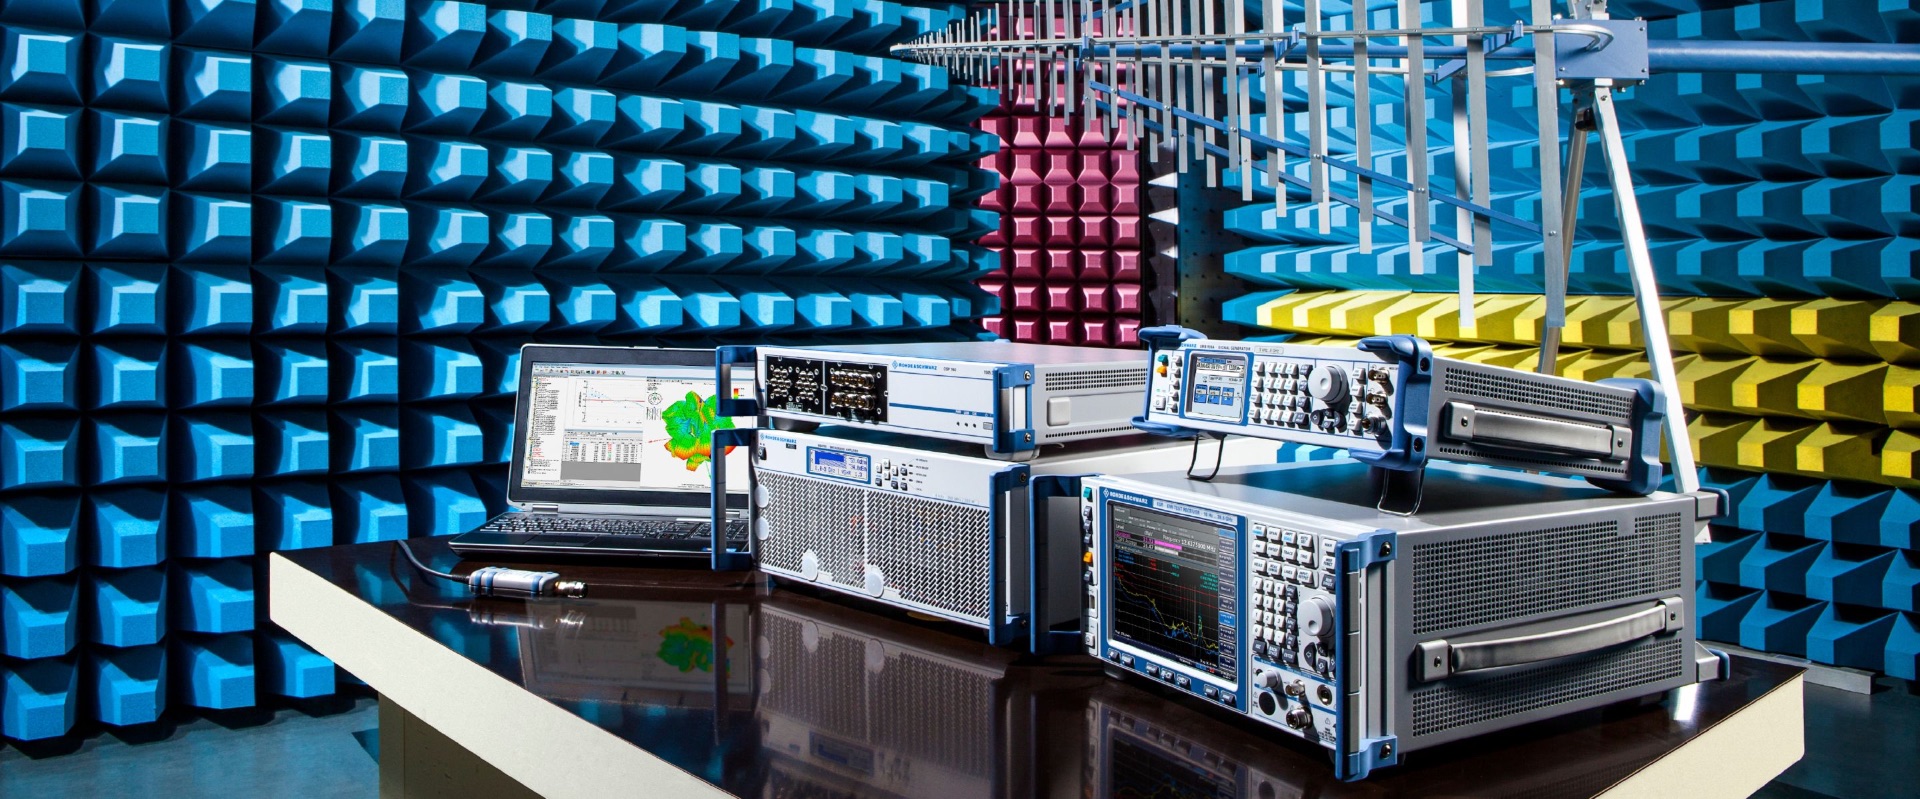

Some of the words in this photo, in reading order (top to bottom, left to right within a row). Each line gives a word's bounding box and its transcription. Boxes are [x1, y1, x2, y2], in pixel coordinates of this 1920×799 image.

[898, 362, 938, 371] ROHDE&SCHWARZ
[765, 434, 797, 443] ROHDE&SCHWARZ
[1110, 491, 1148, 504] ROHDE&SCHWARZ
[1183, 505, 1200, 515] RECEIVER
